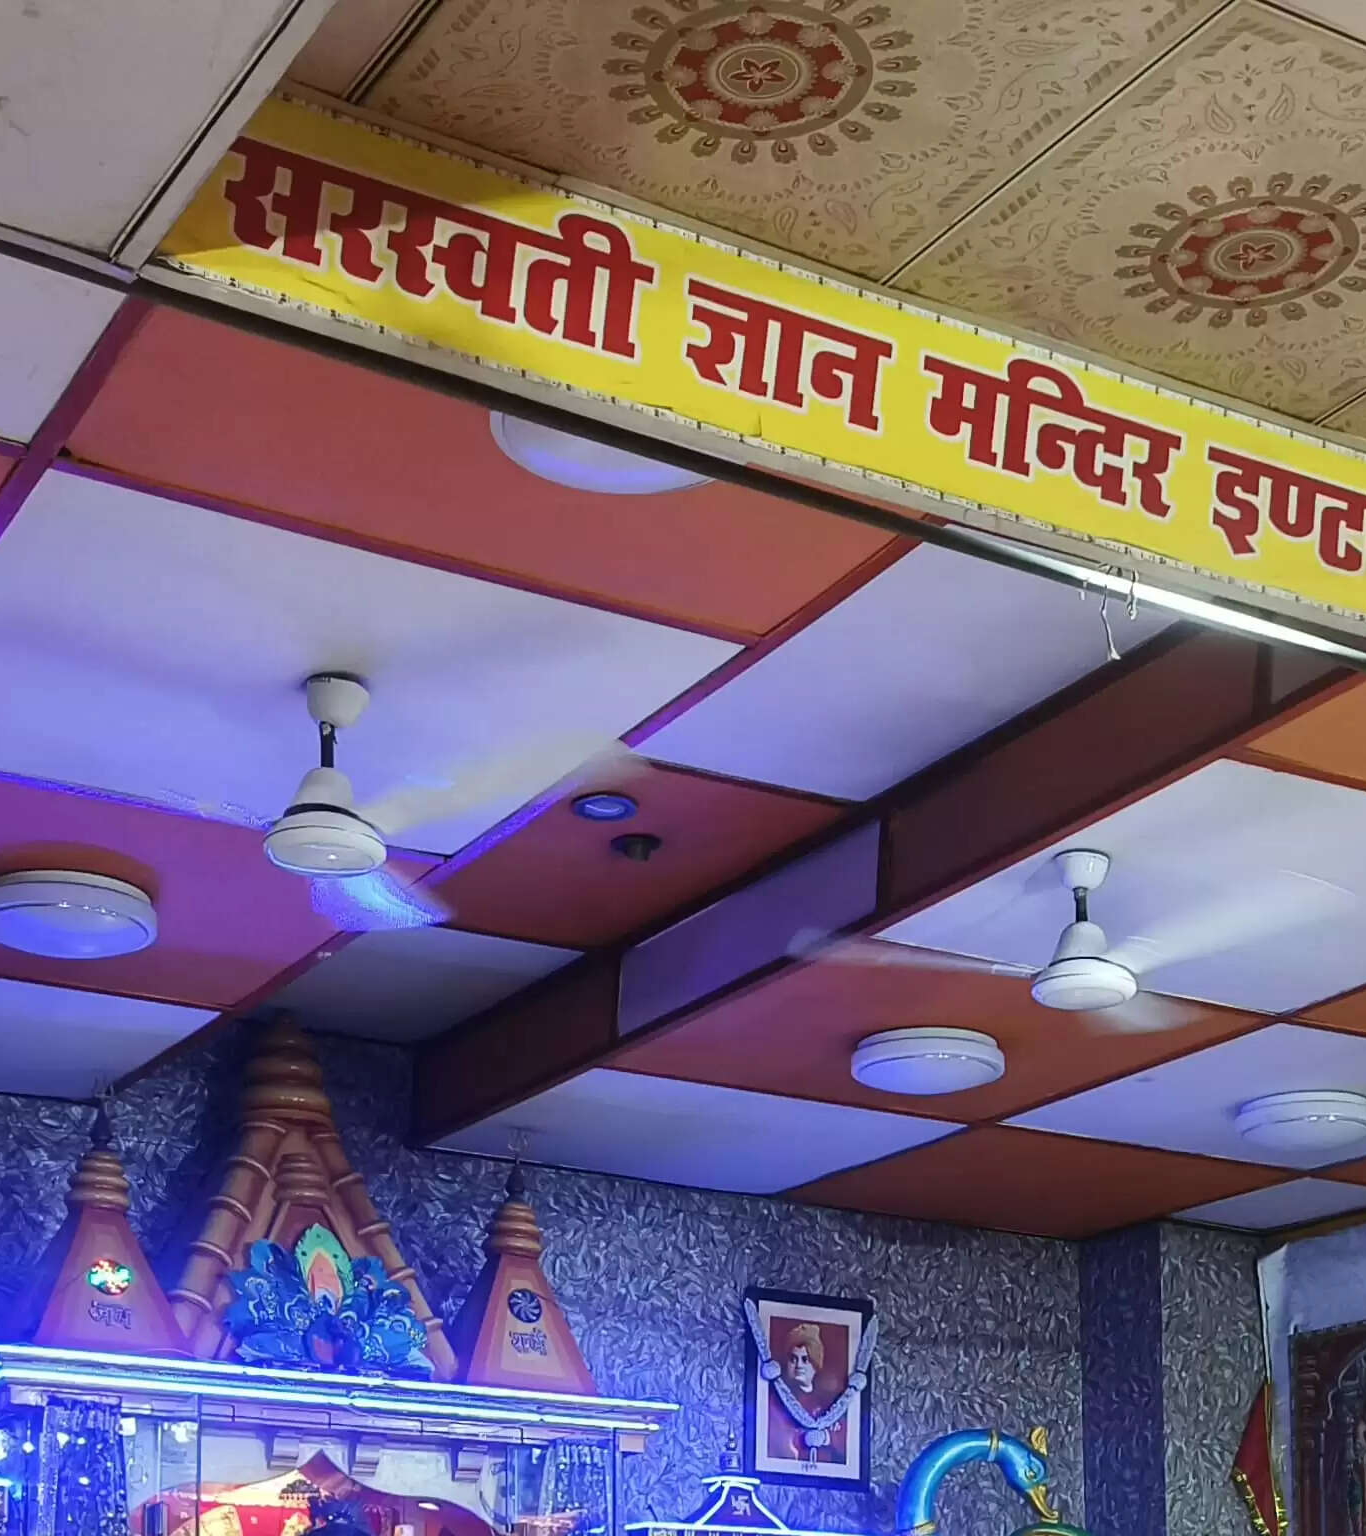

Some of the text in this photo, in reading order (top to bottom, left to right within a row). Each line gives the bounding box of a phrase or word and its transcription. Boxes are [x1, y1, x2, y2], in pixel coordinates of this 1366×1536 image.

[224, 134, 655, 358] सरस्वती
[686, 279, 892, 431] ज्ञान
[925, 357, 1182, 518] मन्दिर
